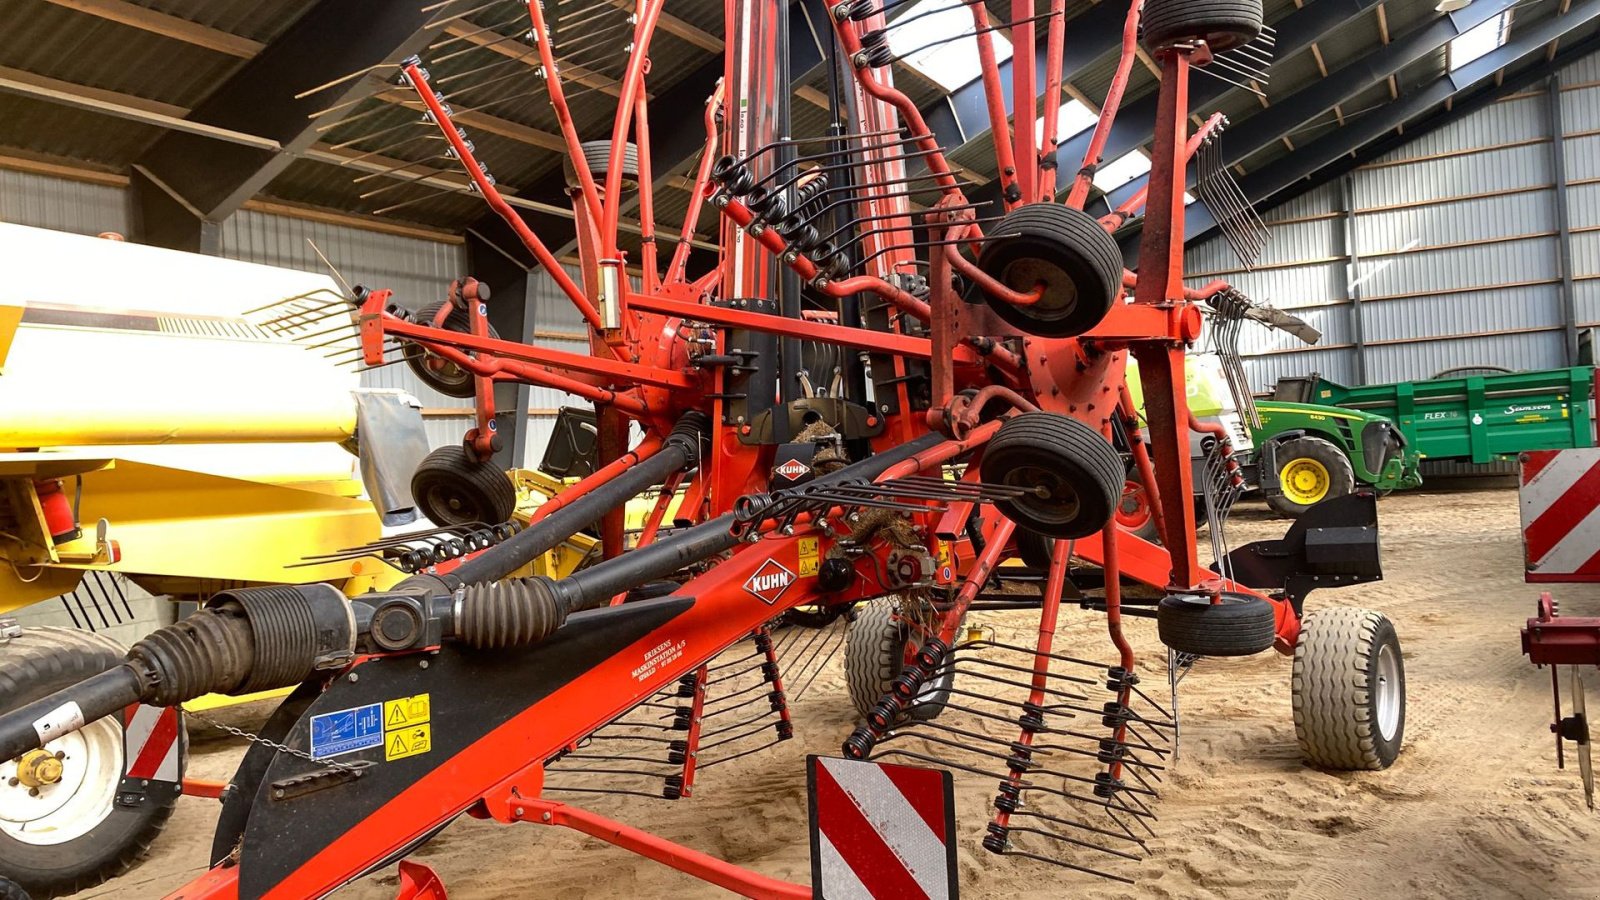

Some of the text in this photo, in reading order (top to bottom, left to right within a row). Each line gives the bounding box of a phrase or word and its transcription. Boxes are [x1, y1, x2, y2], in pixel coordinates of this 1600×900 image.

[1504, 404, 1552, 415] Samson
[780, 465, 806, 474] KUHN
[752, 571, 788, 592] KUHN
[631, 645, 676, 679] MASKINSTATION
[677, 640, 686, 651] A/S
[644, 640, 671, 661] ERIKSENS
